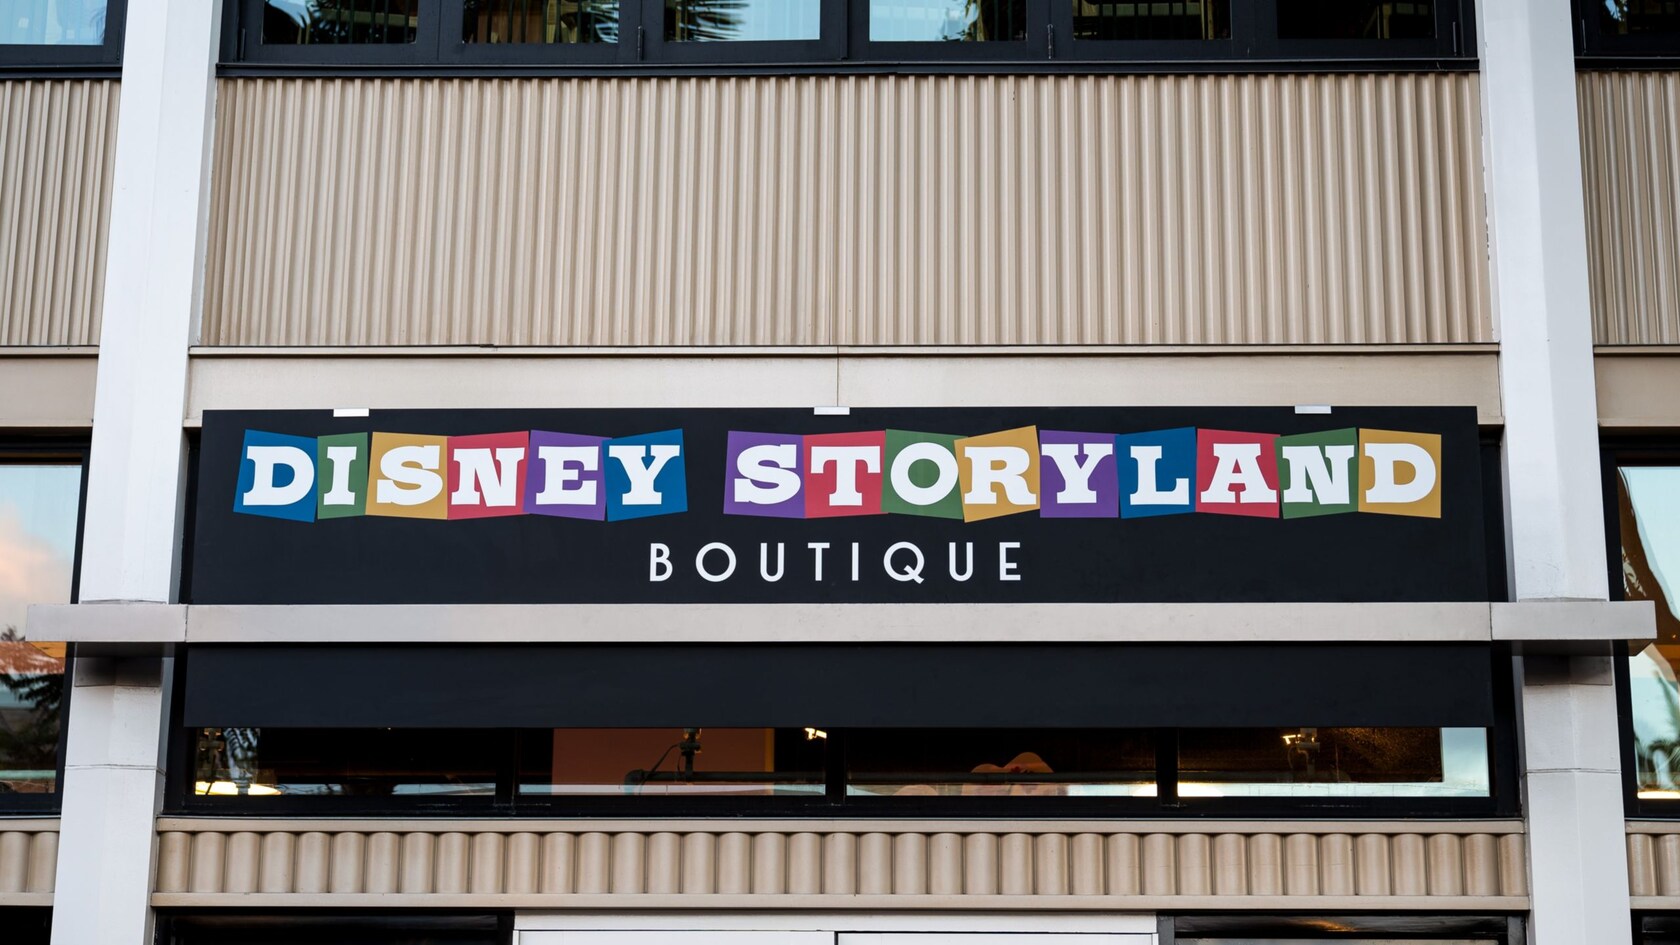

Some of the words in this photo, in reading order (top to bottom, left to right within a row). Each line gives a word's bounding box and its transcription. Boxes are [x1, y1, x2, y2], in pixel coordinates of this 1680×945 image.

[243, 445, 680, 507] DISNEY
[734, 442, 1436, 506] STORYLAND
[649, 541, 1021, 584] BOUTIQUE
